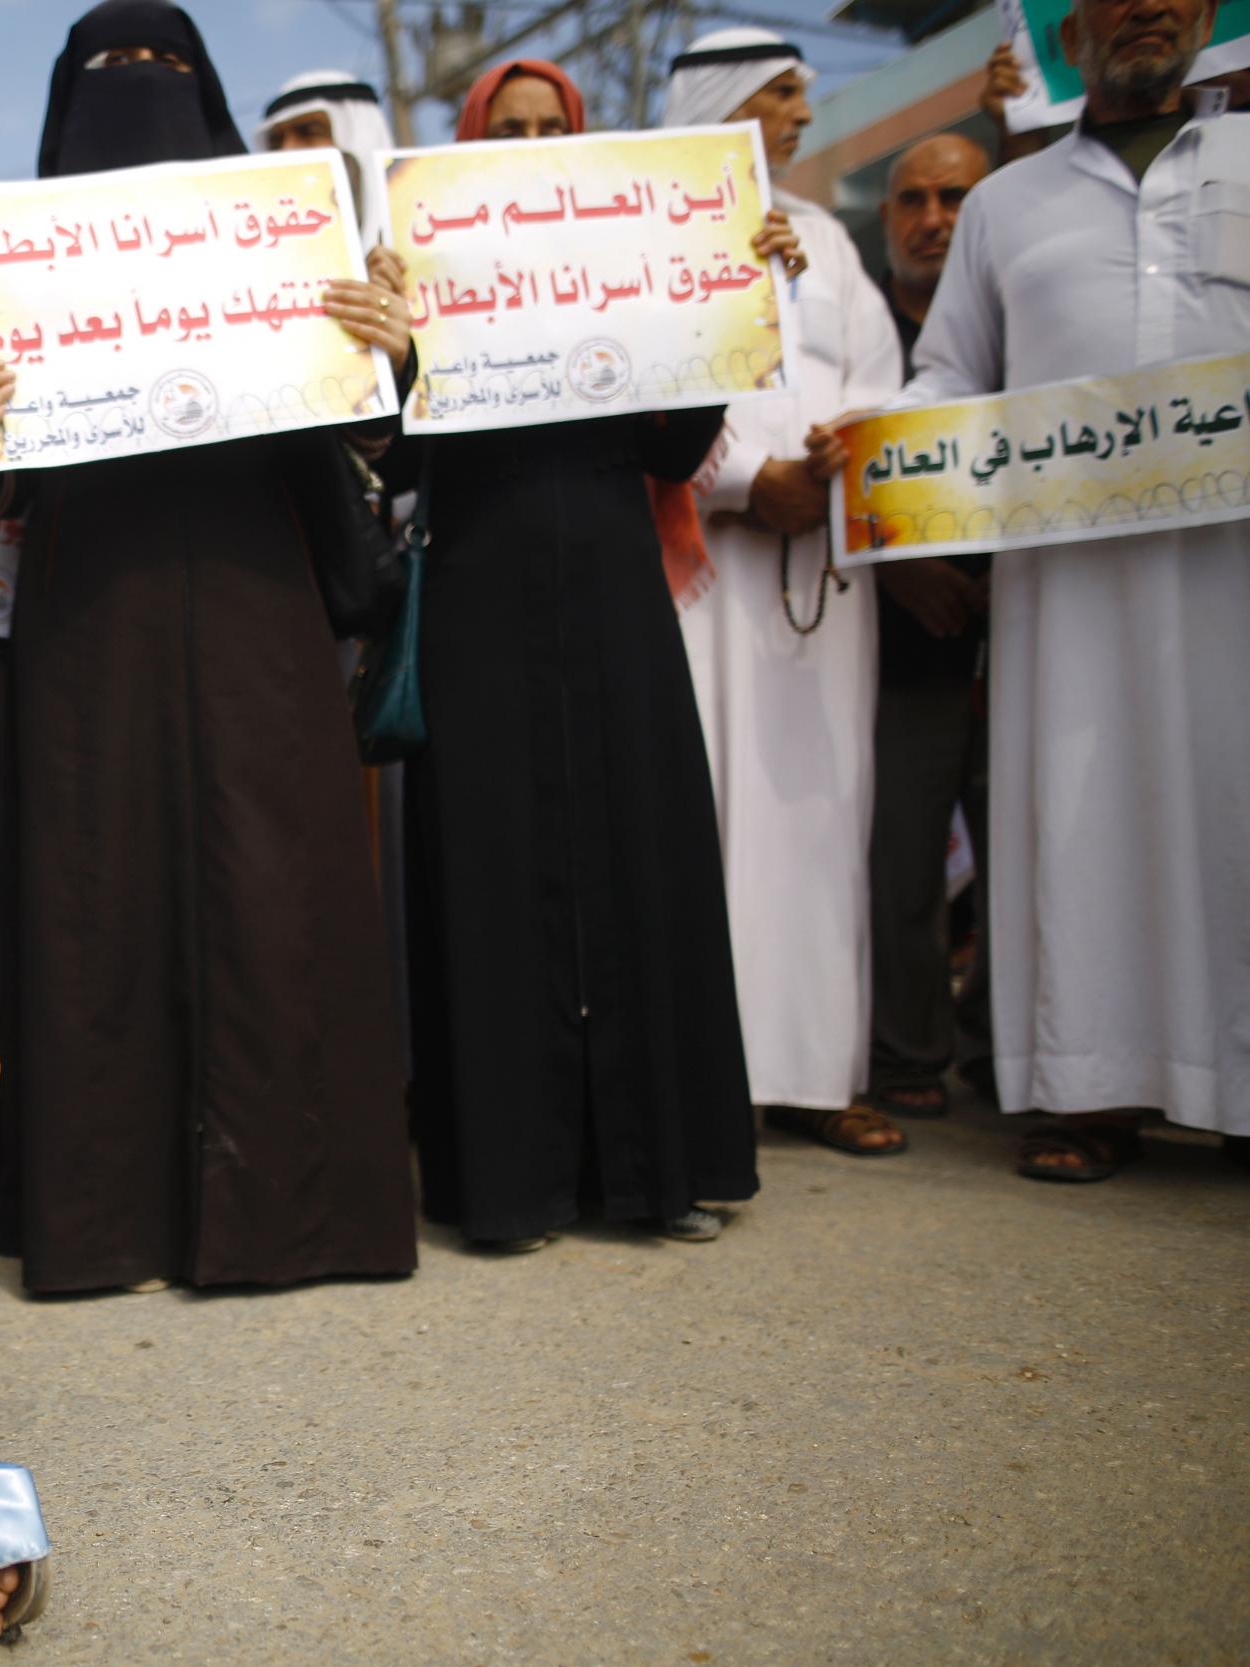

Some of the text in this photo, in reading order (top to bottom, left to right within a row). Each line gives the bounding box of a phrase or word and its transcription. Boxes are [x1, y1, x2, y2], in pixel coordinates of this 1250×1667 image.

[111, 201, 219, 257] أسرانا
[233, 198, 332, 249] حقوق
[412, 165, 736, 245] أين العالم من
[410, 251, 763, 328] حقوق أسرانا الأبطال
[57, 310, 123, 352] بعد
[56, 385, 140, 411] جمعية
[864, 435, 959, 493] العالم
[970, 430, 1010, 487] في
[1020, 405, 1158, 472] الإرهاب
